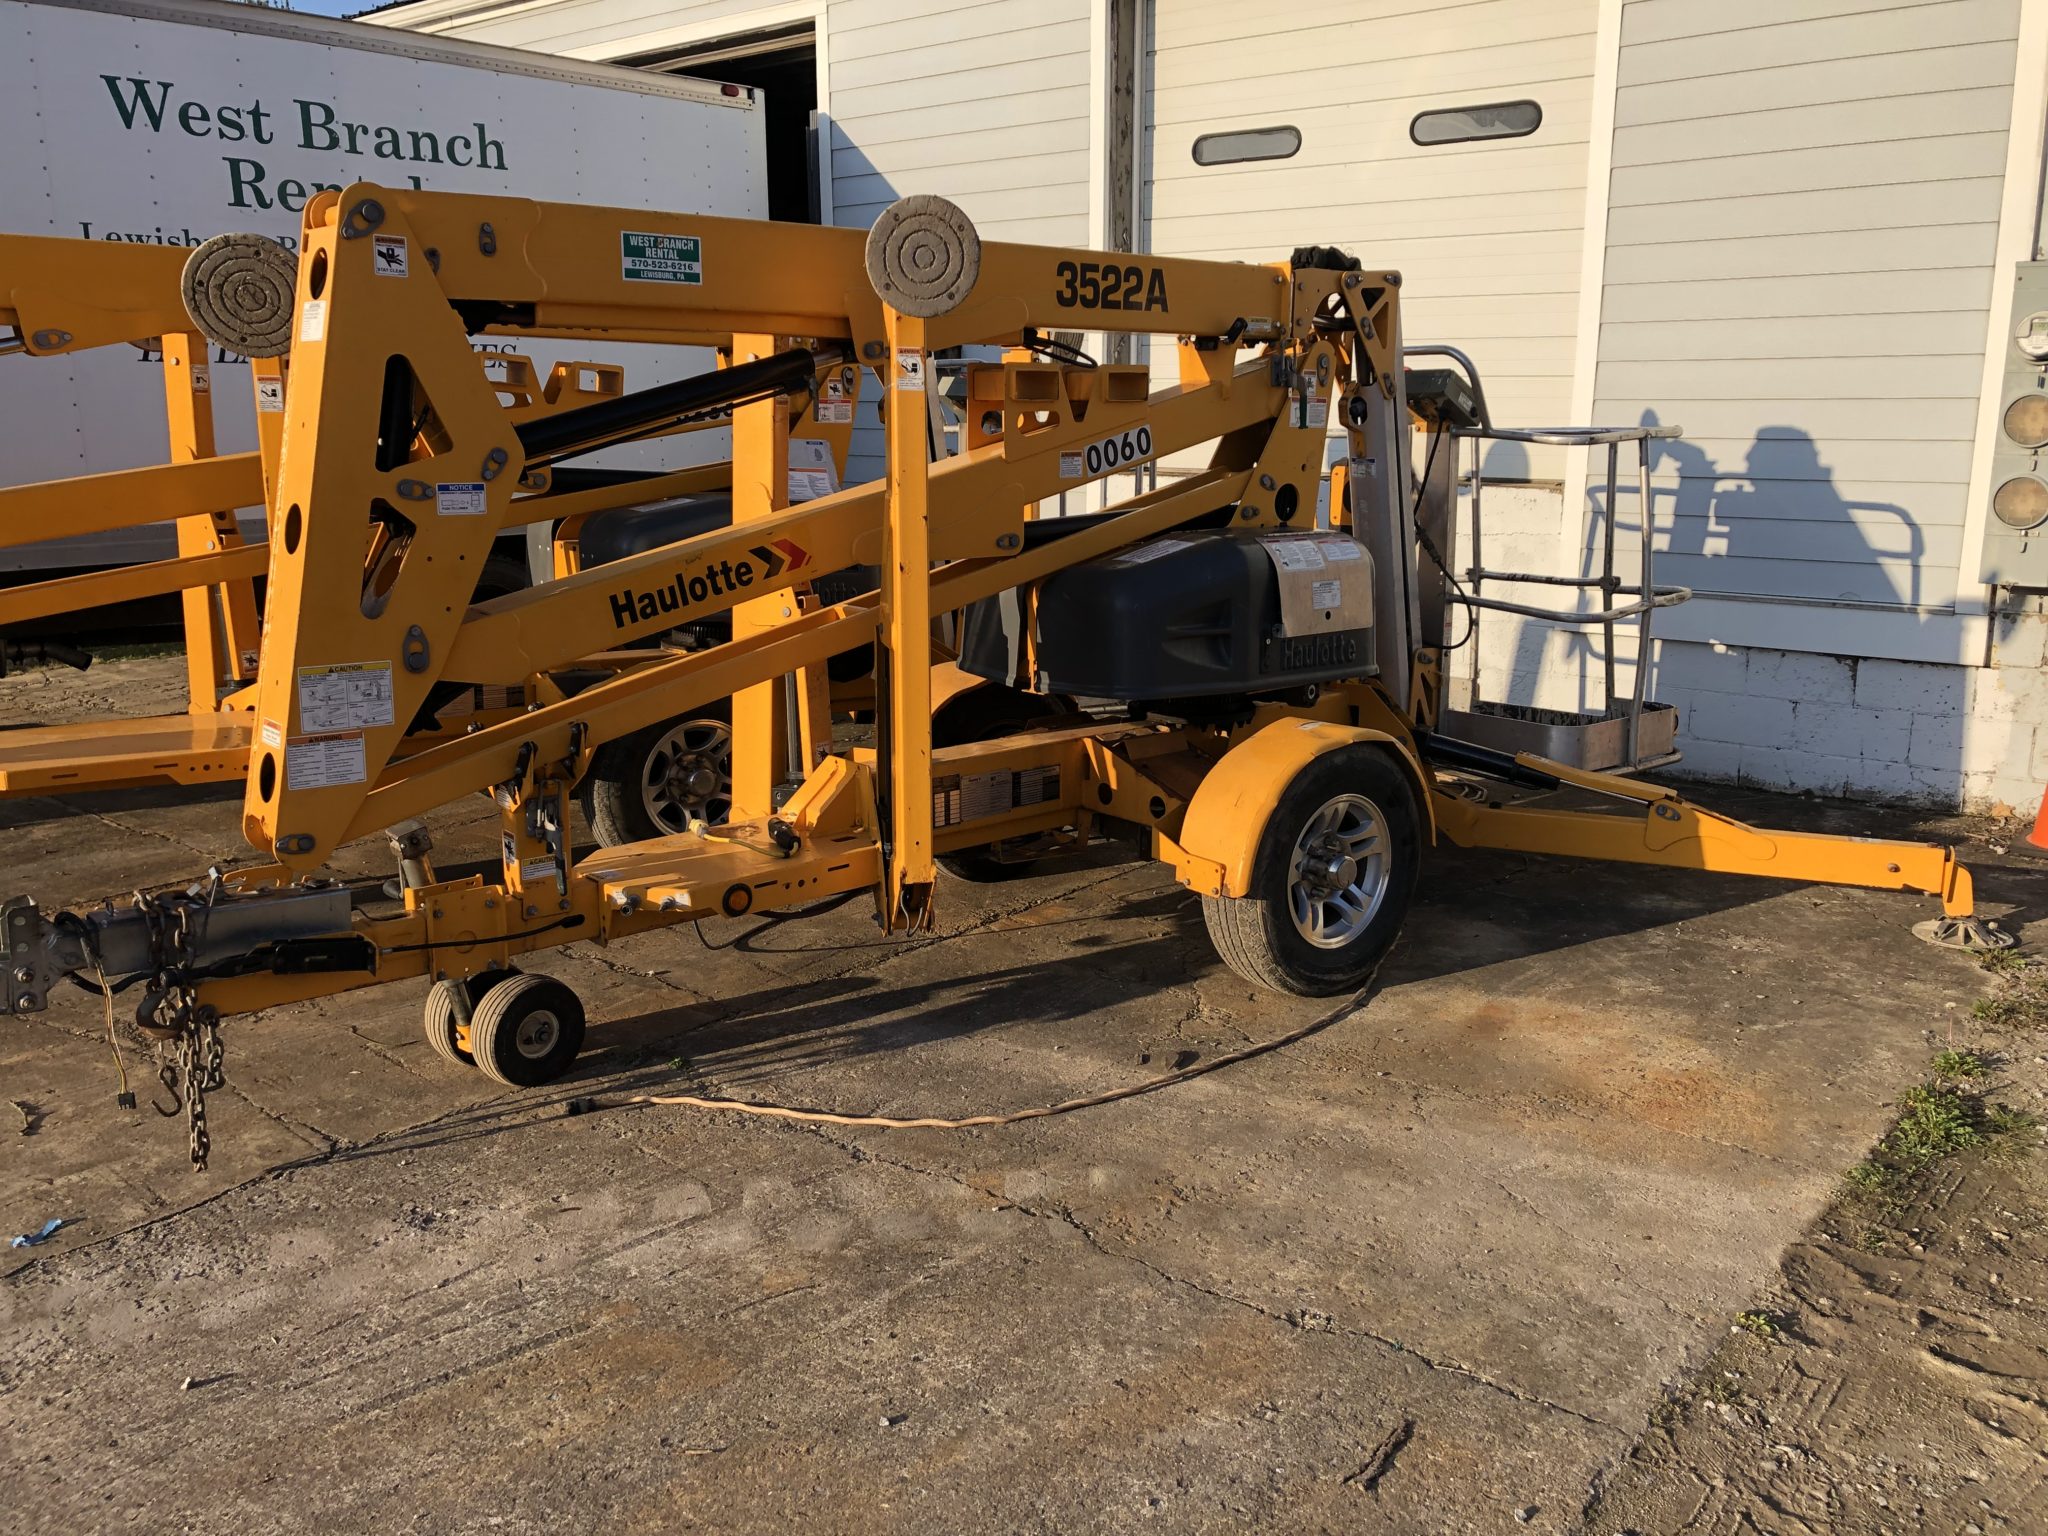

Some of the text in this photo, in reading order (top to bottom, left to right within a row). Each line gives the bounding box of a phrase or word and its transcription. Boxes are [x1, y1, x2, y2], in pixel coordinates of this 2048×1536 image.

[99, 74, 509, 170] West Branch
[629, 235, 694, 250] WEST BRANCH
[645, 247, 679, 259] RENTAL
[631, 259, 694, 271] 570-523-6216
[1056, 261, 1169, 313] 3522A
[1086, 427, 1151, 474] 0060
[609, 560, 753, 629] Haulotte
[1283, 635, 1357, 669] Haulotte
[335, 665, 363, 673] CAUTION
[314, 734, 343, 743] WARNING
[533, 856, 556, 865] CAUTIO
